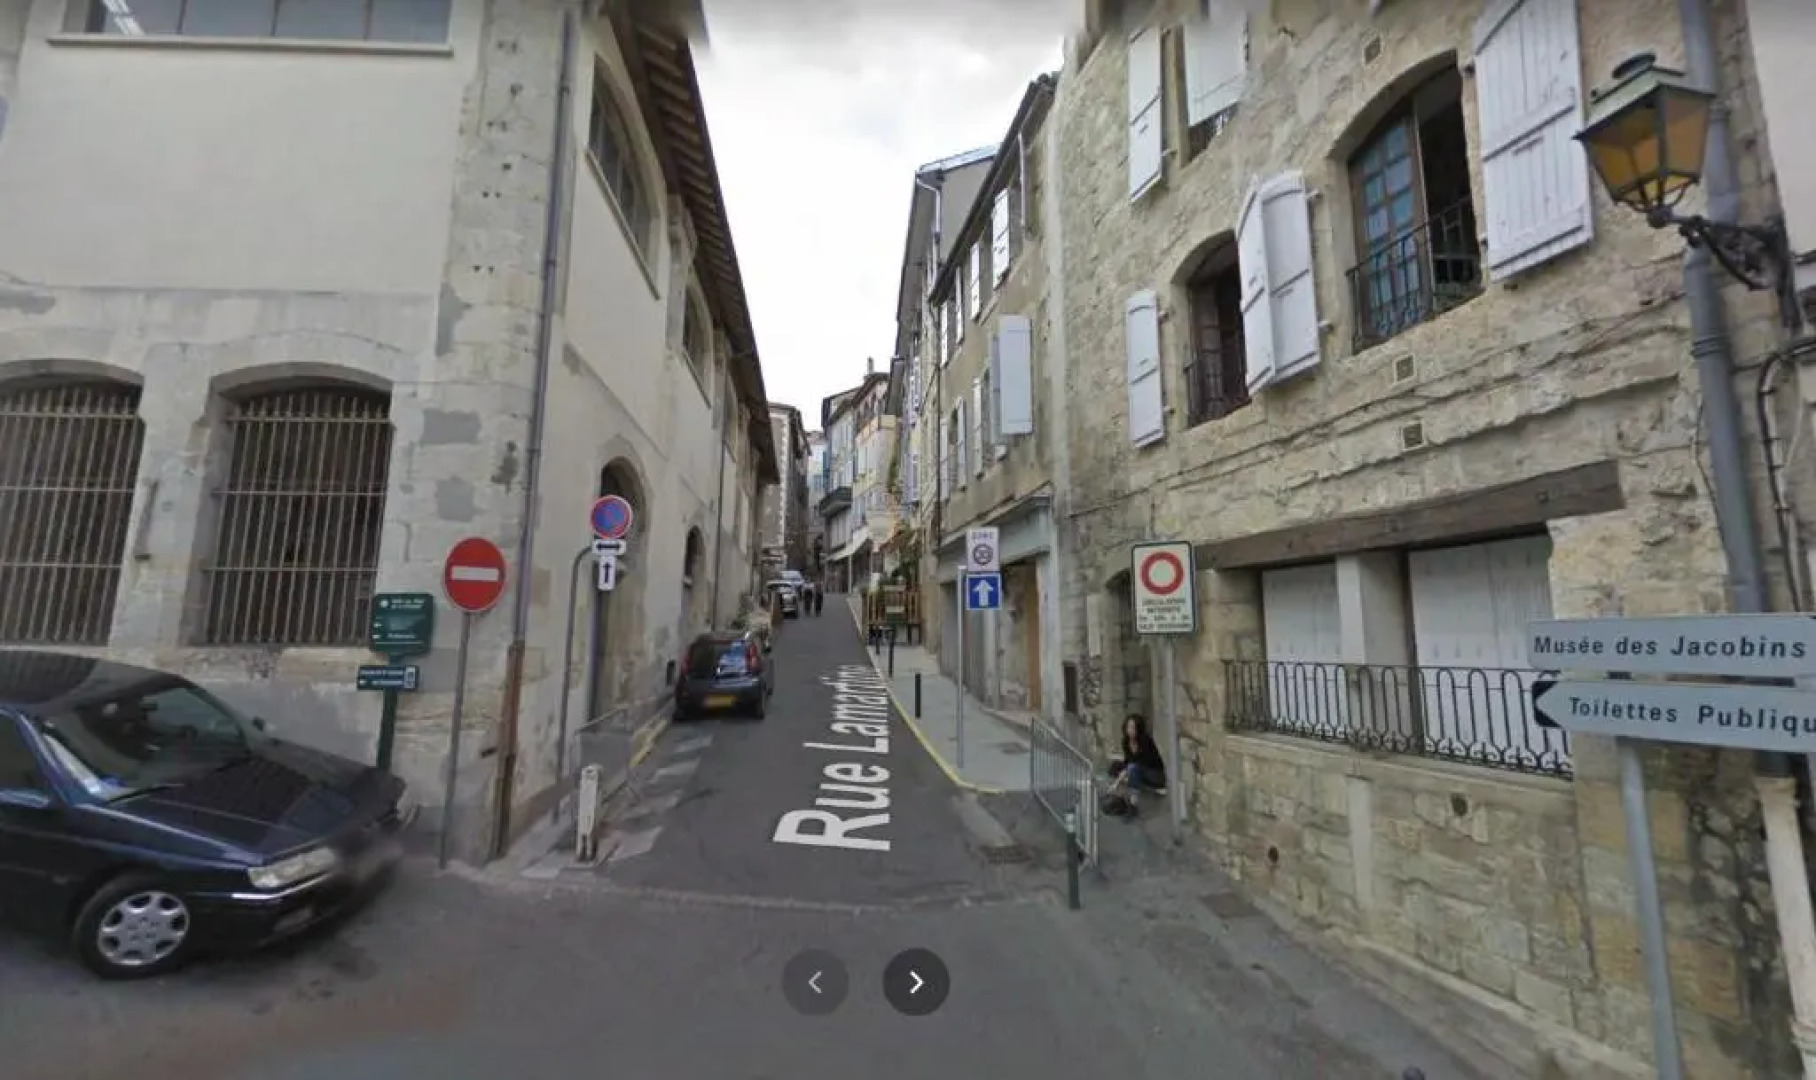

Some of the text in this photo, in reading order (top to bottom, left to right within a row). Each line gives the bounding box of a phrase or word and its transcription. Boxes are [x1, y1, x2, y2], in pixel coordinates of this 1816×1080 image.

[1533, 635, 1807, 658] Musée des Jacobins
[1569, 696, 1678, 723] Toilettes
